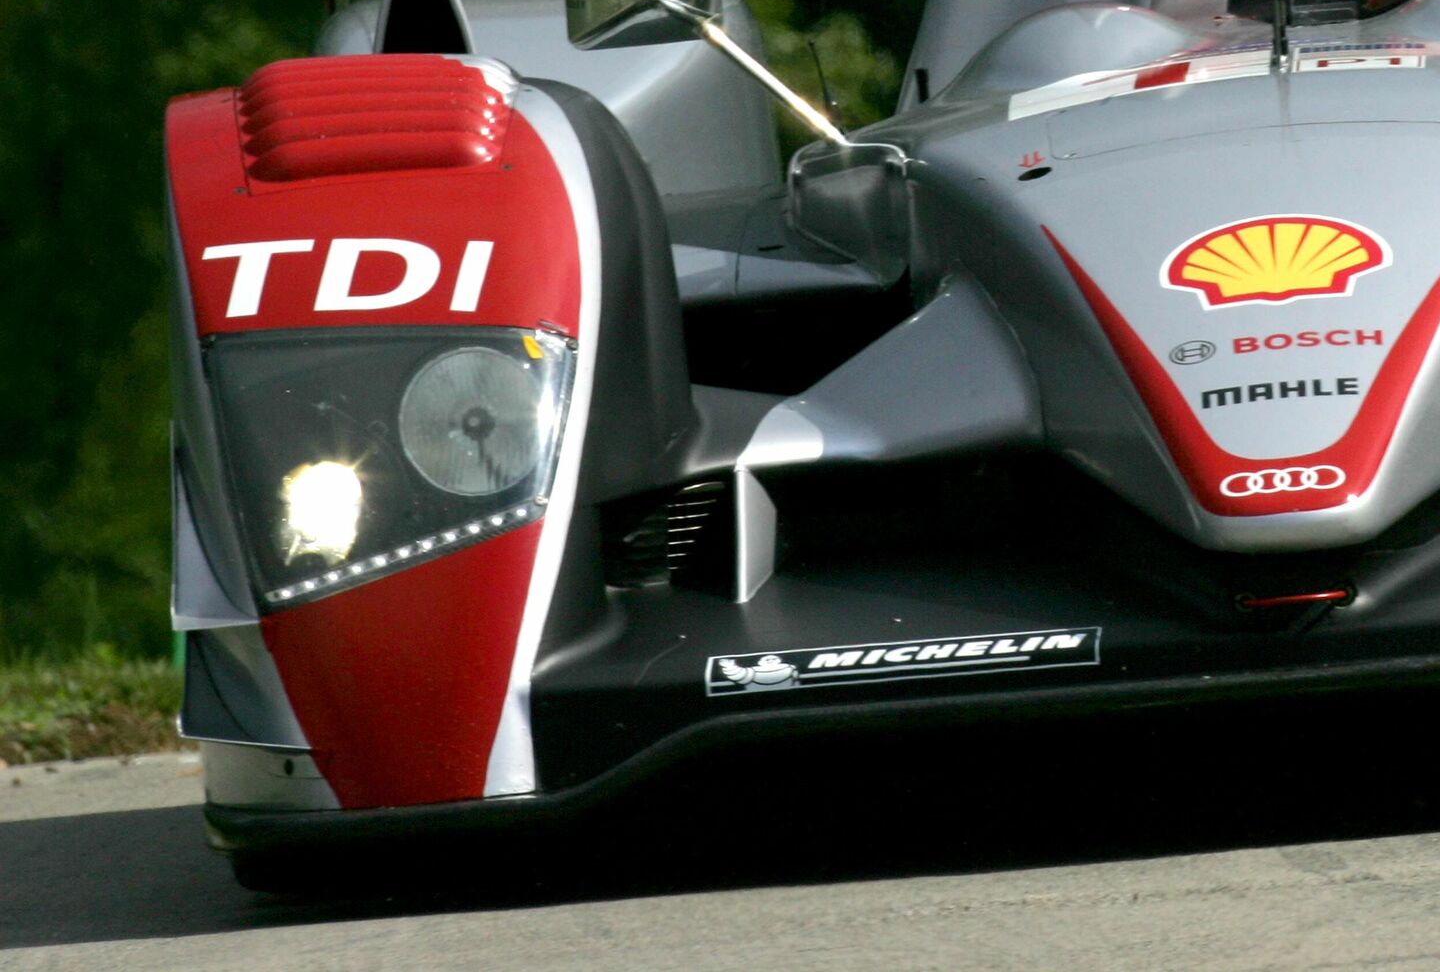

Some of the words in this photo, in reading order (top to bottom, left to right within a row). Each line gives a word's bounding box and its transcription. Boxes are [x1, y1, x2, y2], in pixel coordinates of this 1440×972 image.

[202, 238, 495, 318] TDI
[1231, 329, 1384, 355] BOSCH
[1200, 378, 1361, 409] MAHLE
[807, 632, 1088, 669] MICHELIN
